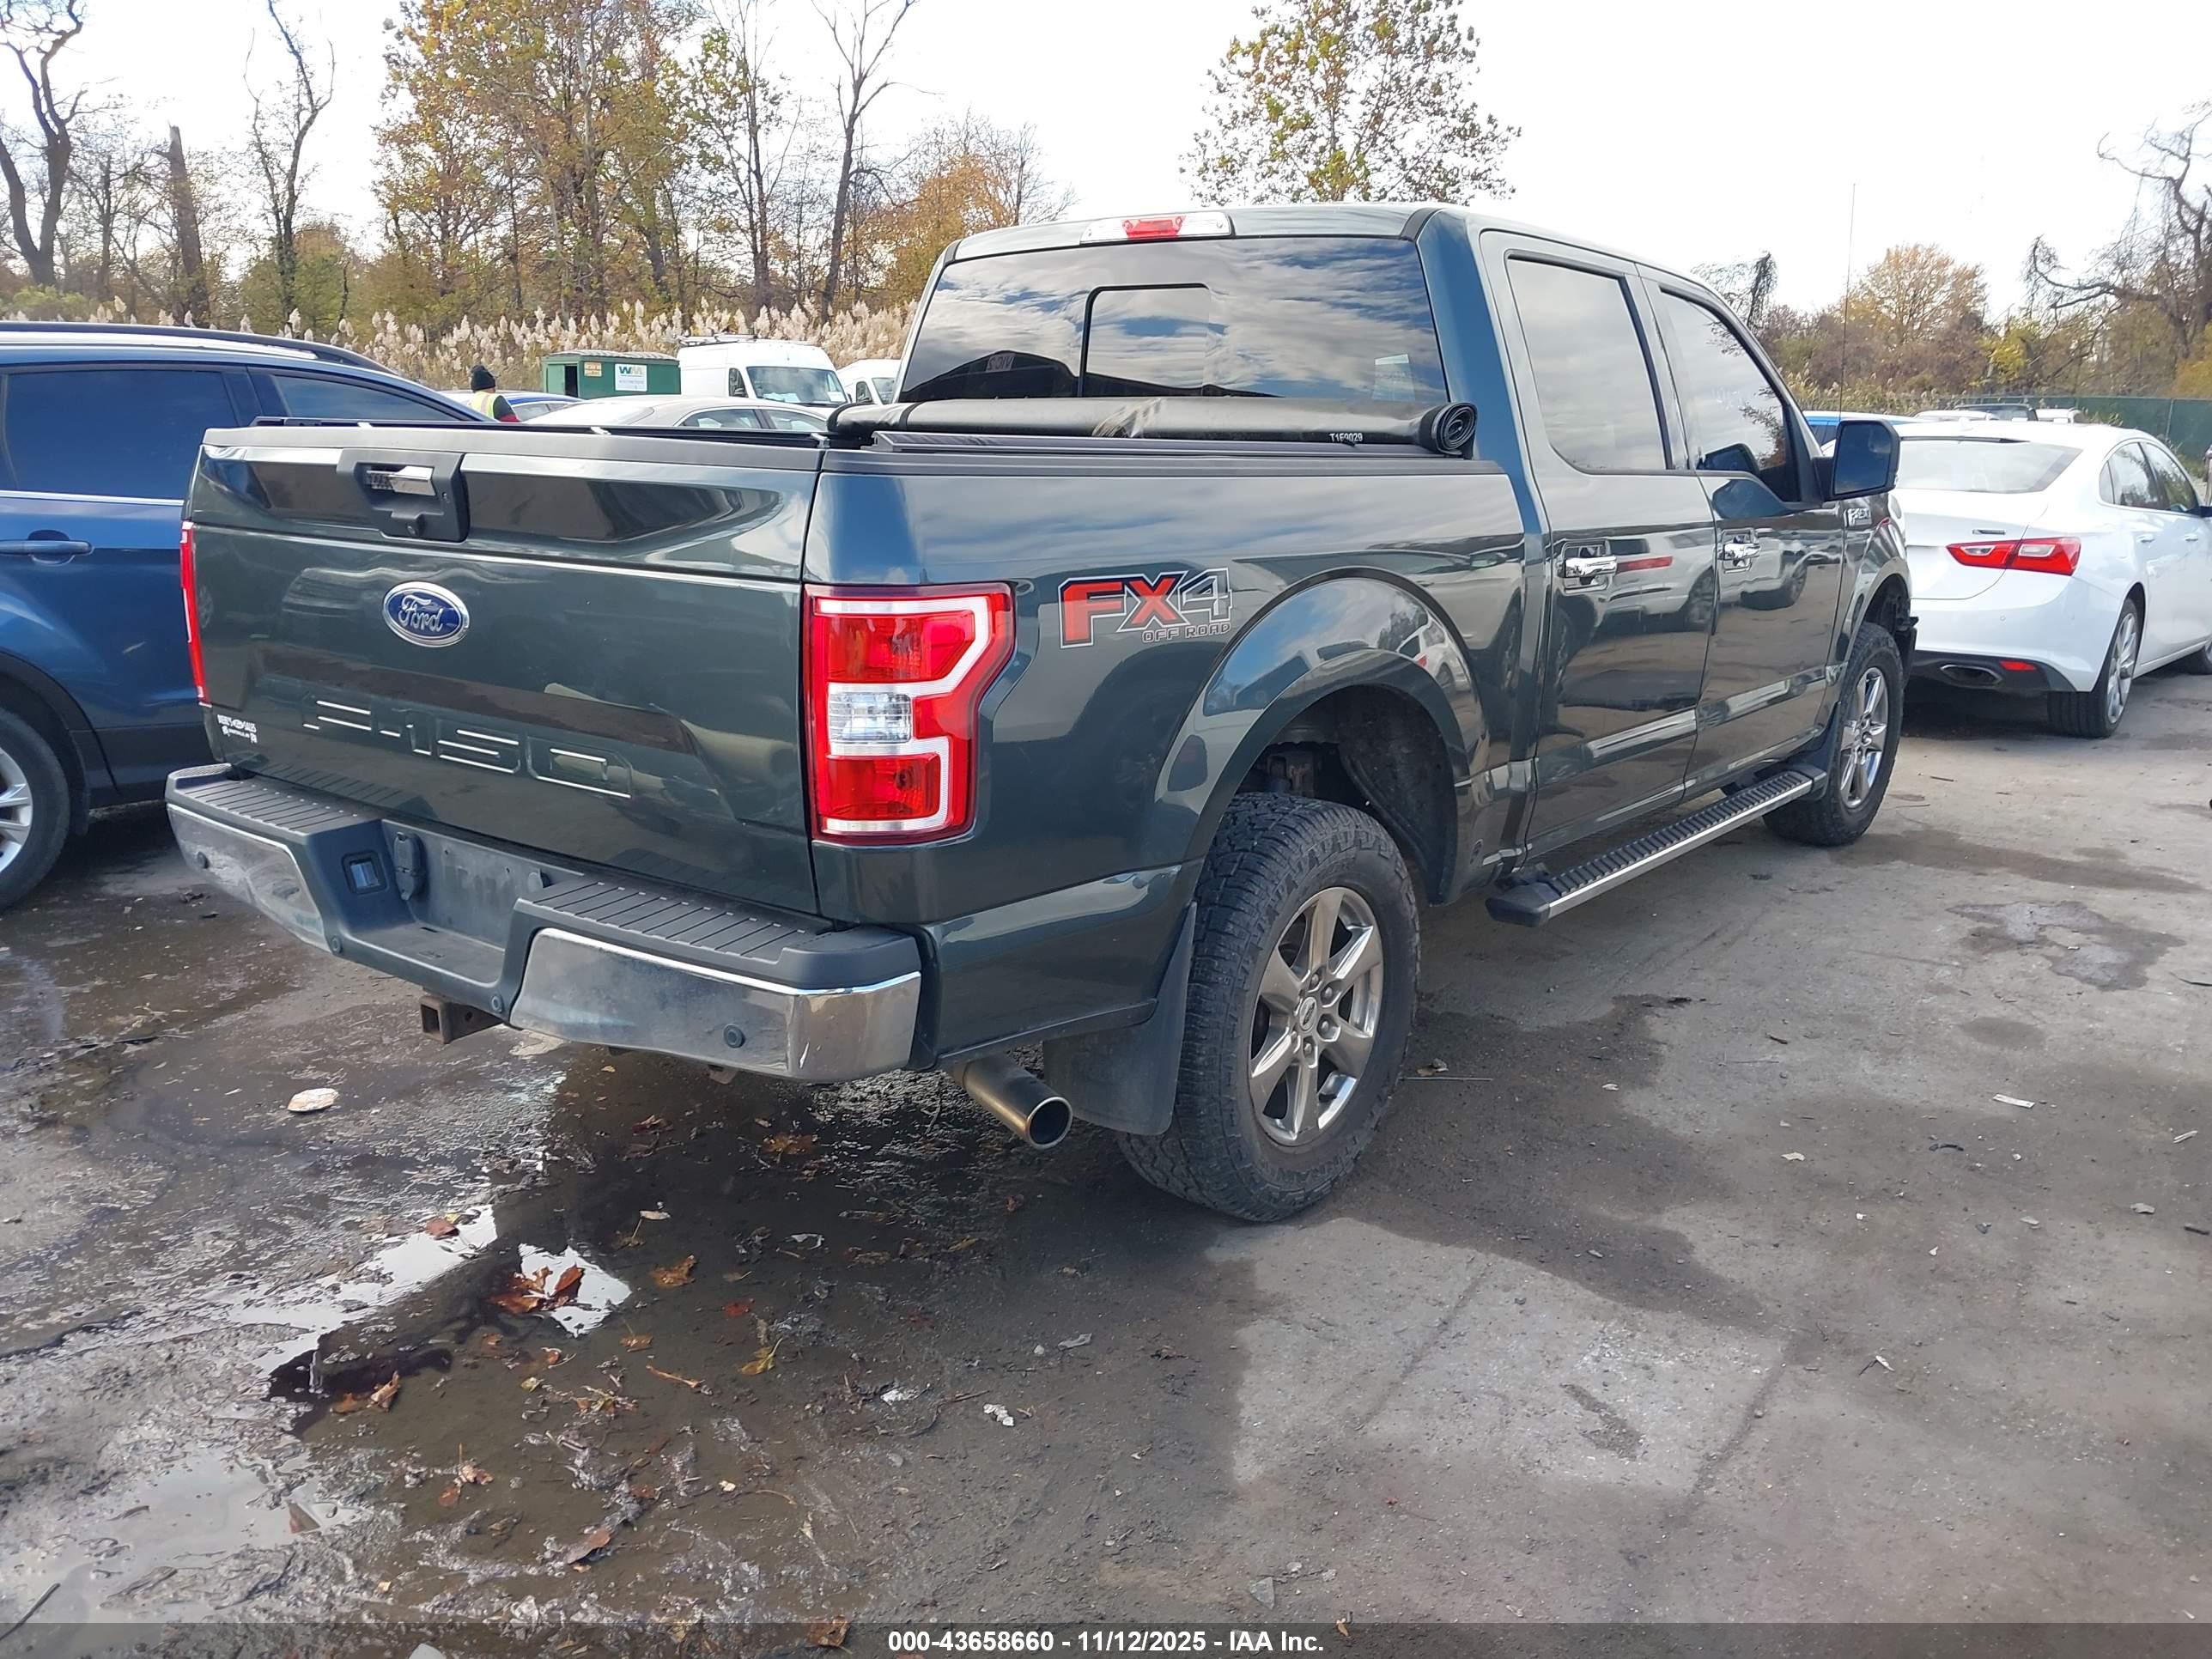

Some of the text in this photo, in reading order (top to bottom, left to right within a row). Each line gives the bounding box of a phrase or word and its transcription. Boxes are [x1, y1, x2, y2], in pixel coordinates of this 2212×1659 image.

[398, 594, 444, 633] Ford
[1057, 567, 1233, 649] FX4
[1141, 622, 1232, 644] OFF ROAD
